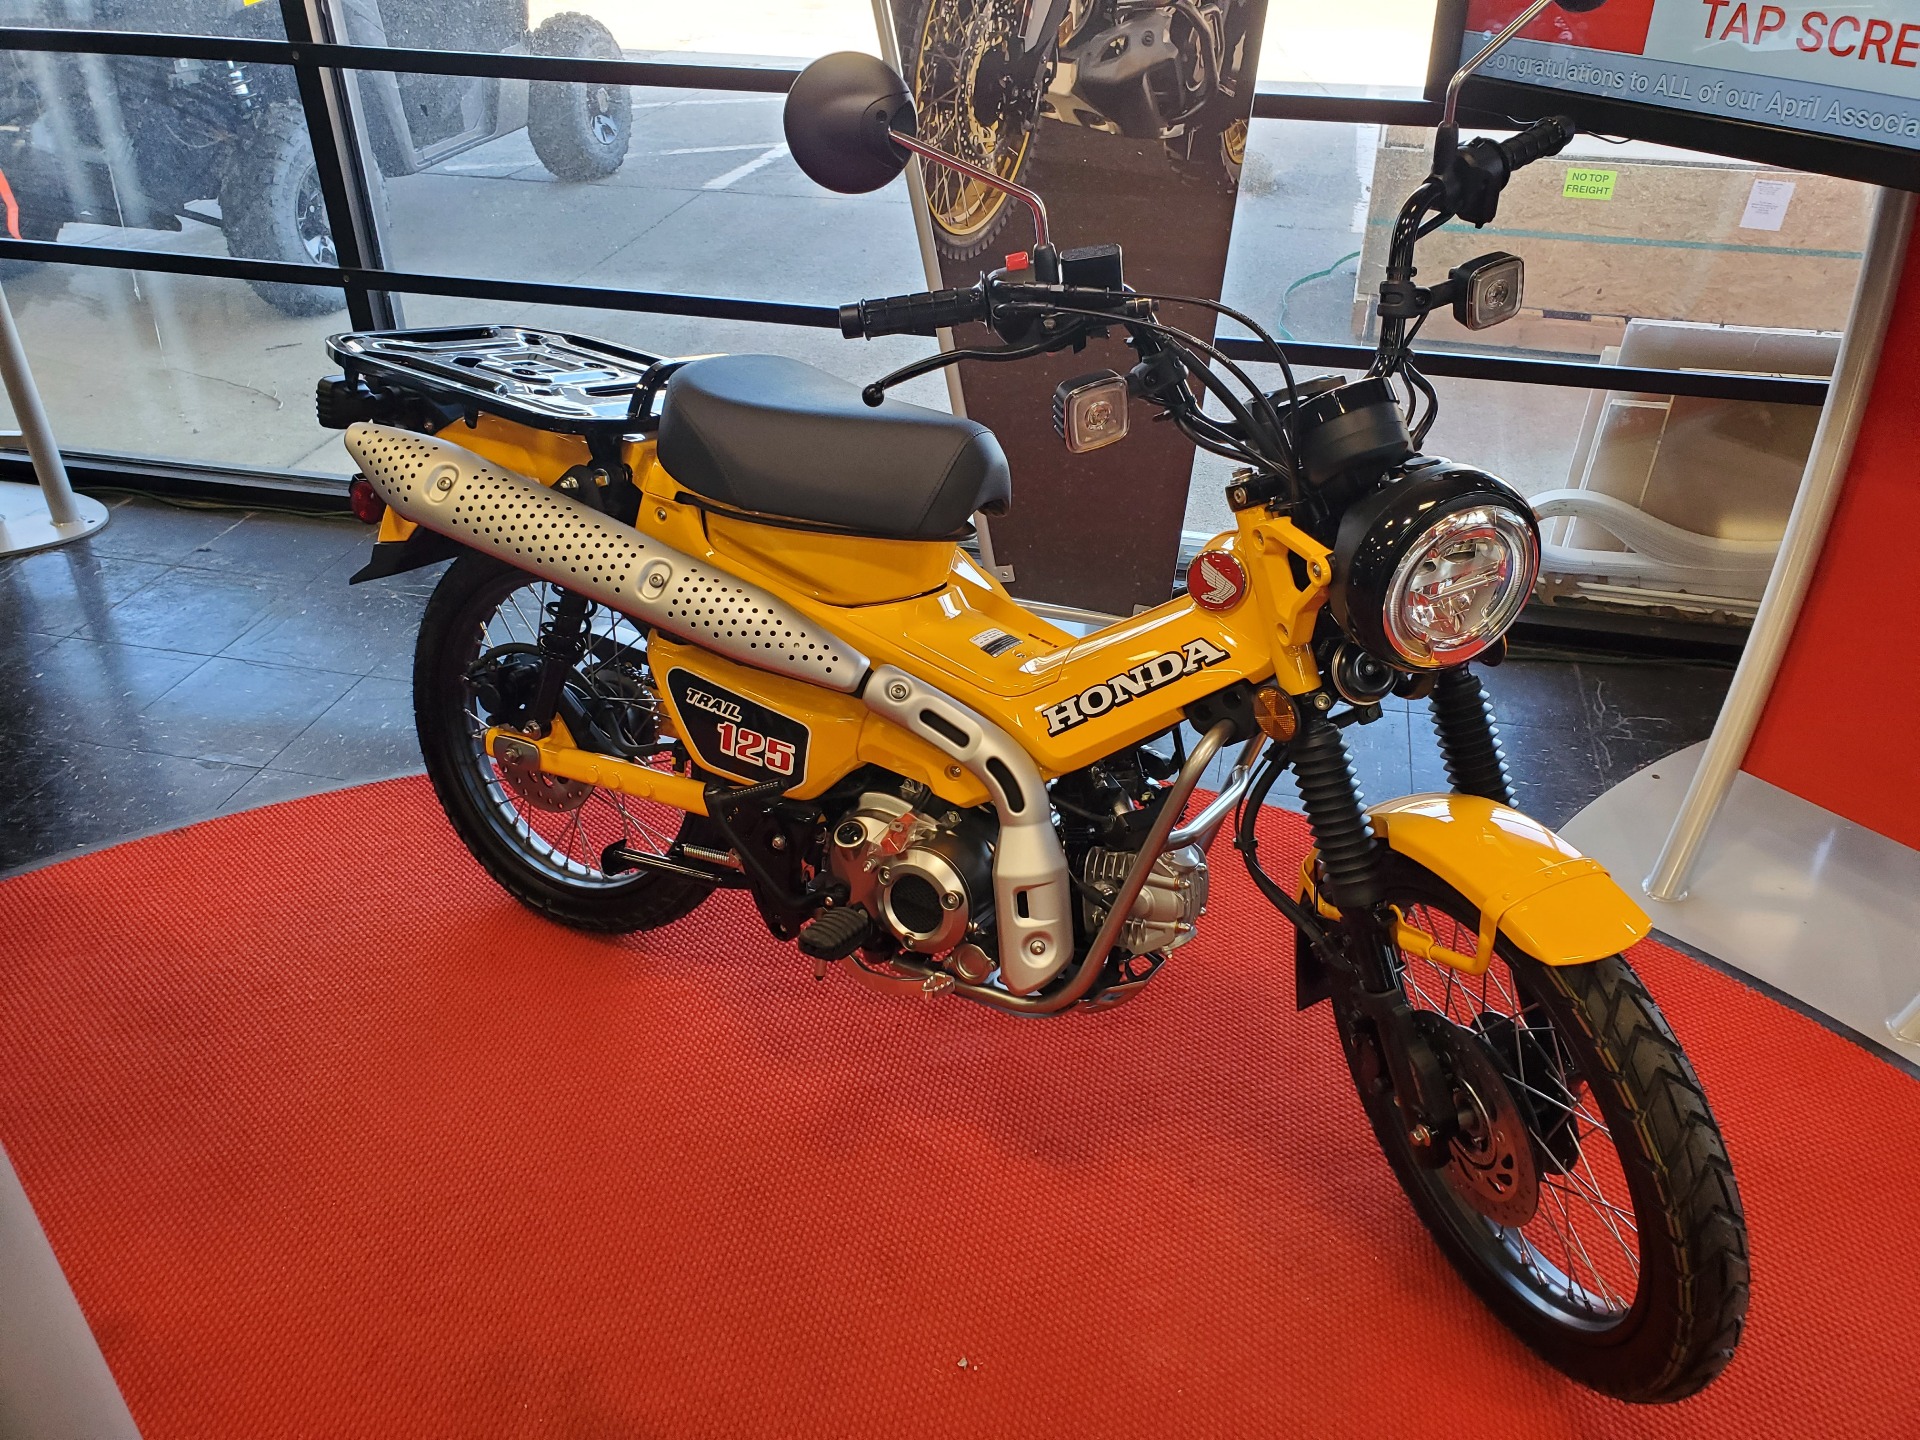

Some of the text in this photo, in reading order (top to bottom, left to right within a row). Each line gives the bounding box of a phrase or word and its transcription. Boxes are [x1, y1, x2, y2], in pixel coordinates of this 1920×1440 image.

[1702, 0, 1920, 68] TAP SCRE
[1629, 71, 1650, 93] to
[1653, 73, 1692, 101] ALL
[1698, 81, 1724, 105] of
[1726, 89, 1764, 110] our
[1765, 91, 1821, 121] April
[1823, 100, 1920, 138] Associa
[1566, 184, 1611, 195] FREIGHT
[1572, 172, 1609, 182] NO TOP
[686, 687, 743, 723] TRAIL
[1042, 637, 1231, 737] HONDA
[717, 721, 796, 776] 125
